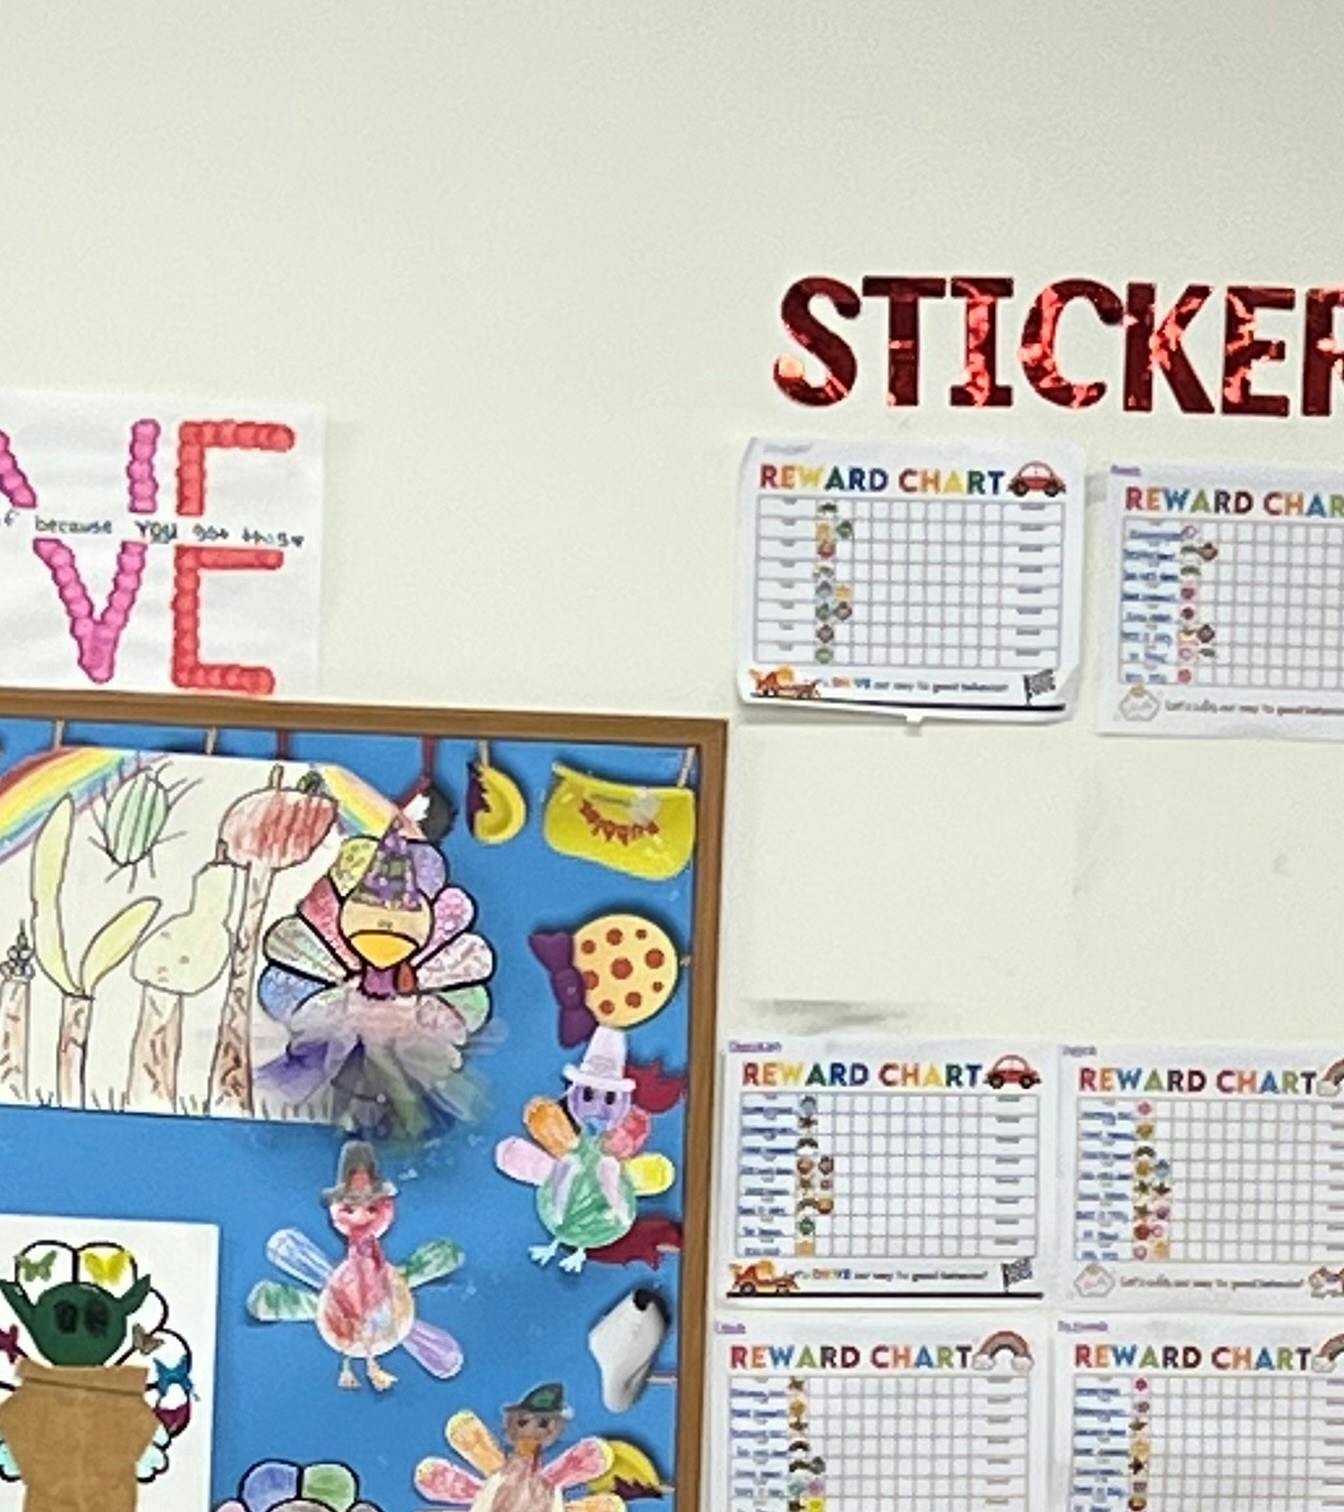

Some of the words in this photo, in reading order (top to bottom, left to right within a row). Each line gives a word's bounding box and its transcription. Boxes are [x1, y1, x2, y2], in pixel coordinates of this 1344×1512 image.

[759, 464, 889, 492] REWARD
[898, 467, 1005, 495] CHART
[1124, 486, 1254, 514] REWARD
[34, 514, 113, 536] because
[742, 1062, 869, 1087] REWARD
[878, 1062, 983, 1088] CHART
[1078, 1067, 1207, 1093] REWARD
[1216, 1070, 1317, 1095] CHART
[730, 1345, 861, 1370] REWARD
[869, 1345, 973, 1370] CHART
[1073, 1344, 1203, 1370] REWARD
[1210, 1346, 1312, 1371] CHART
